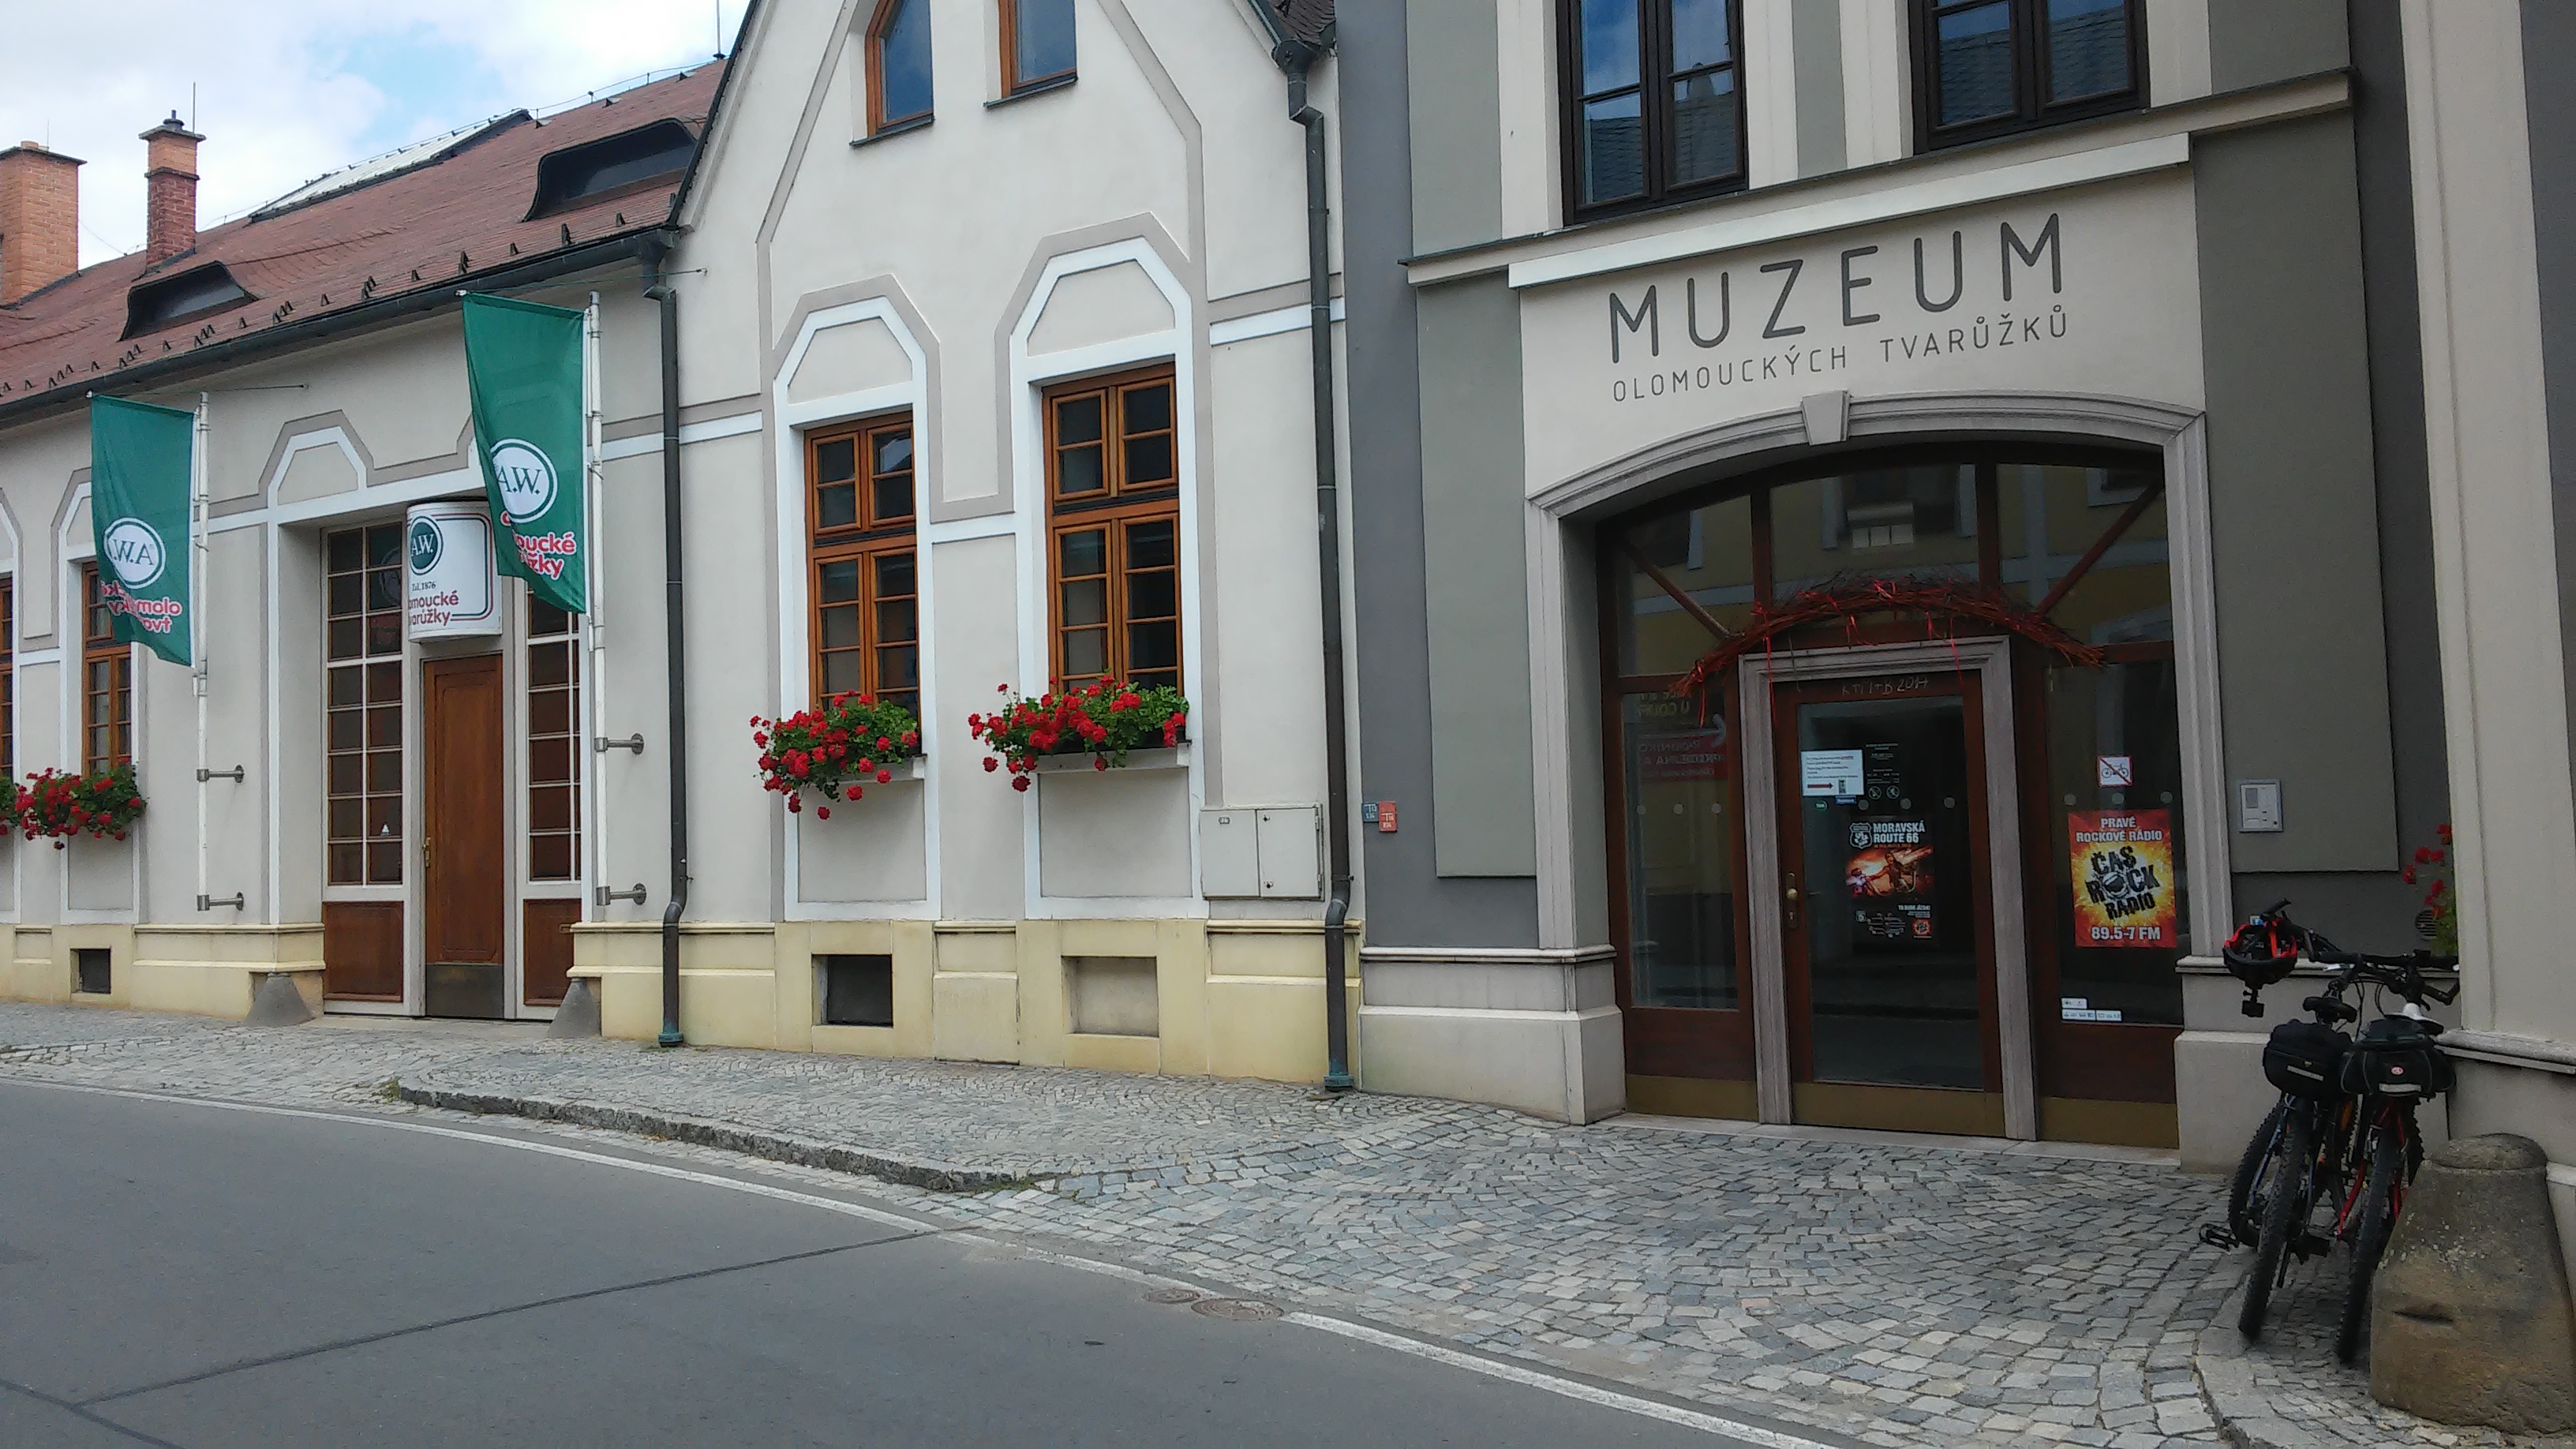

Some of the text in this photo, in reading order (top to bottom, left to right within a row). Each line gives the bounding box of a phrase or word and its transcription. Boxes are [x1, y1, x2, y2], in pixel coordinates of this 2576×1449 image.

[1610, 212, 2062, 365] MUZEUM
[1612, 305, 2068, 402] OLOMOUCKÝCH TVARŮŽKŮ
[421, 581, 436, 590] 1876
[1873, 820, 1926, 833] MORAVSKÁ
[2101, 816, 2136, 828] PRAVÉ
[1874, 833, 1919, 843] ROUTE 66
[2076, 831, 2126, 842] ROCKOVÉ
[2091, 845, 2136, 875] ČAS
[2085, 865, 2161, 903] ROCK
[2139, 927, 2161, 940] FM
